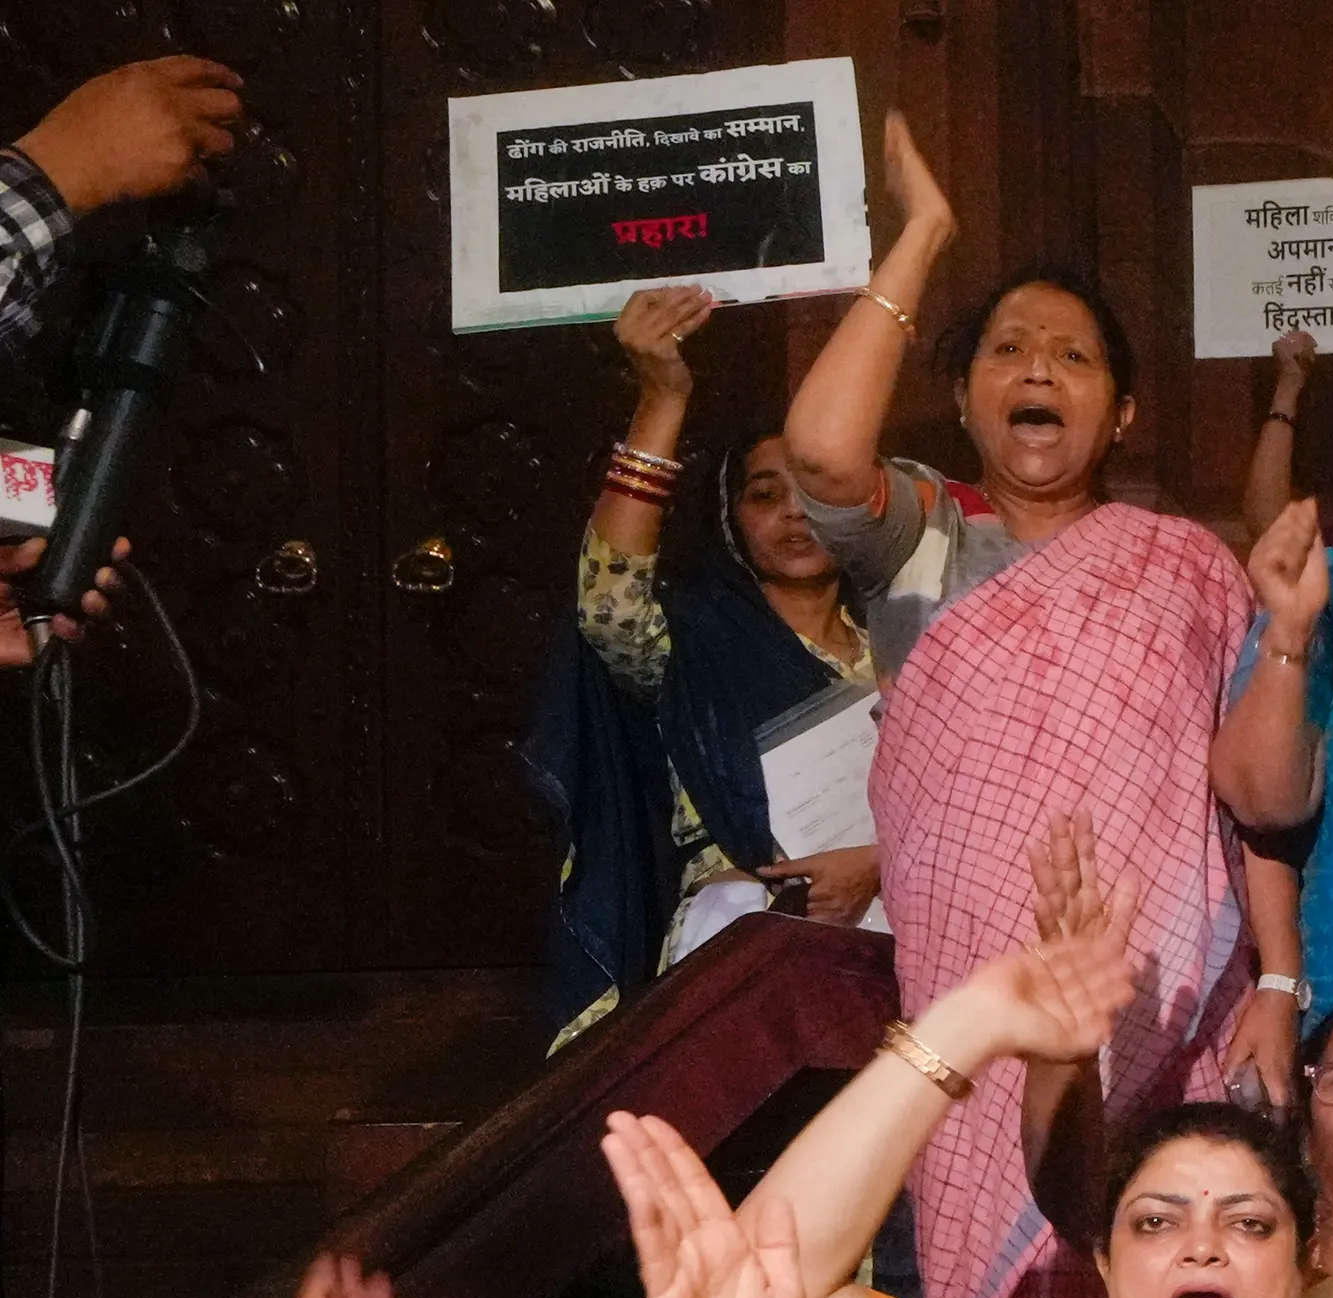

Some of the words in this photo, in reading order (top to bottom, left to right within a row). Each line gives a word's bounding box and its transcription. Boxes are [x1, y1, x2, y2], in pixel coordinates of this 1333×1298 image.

[507, 139, 544, 160] ढोंग
[549, 139, 568, 154] की
[571, 128, 650, 152] राजनीति,
[654, 126, 699, 147] दिखावे
[704, 128, 722, 140] का
[725, 114, 804, 139] सम्मान,
[505, 172, 609, 203] महिलाओं
[614, 175, 632, 192] के
[671, 173, 695, 187] पर
[699, 153, 784, 186] कांग्रेस
[787, 160, 812, 176] का
[611, 212, 708, 248] प्रहार!
[1245, 201, 1309, 230] महिला
[1252, 276, 1283, 296] कतई
[1286, 265, 1326, 295] नहीं
